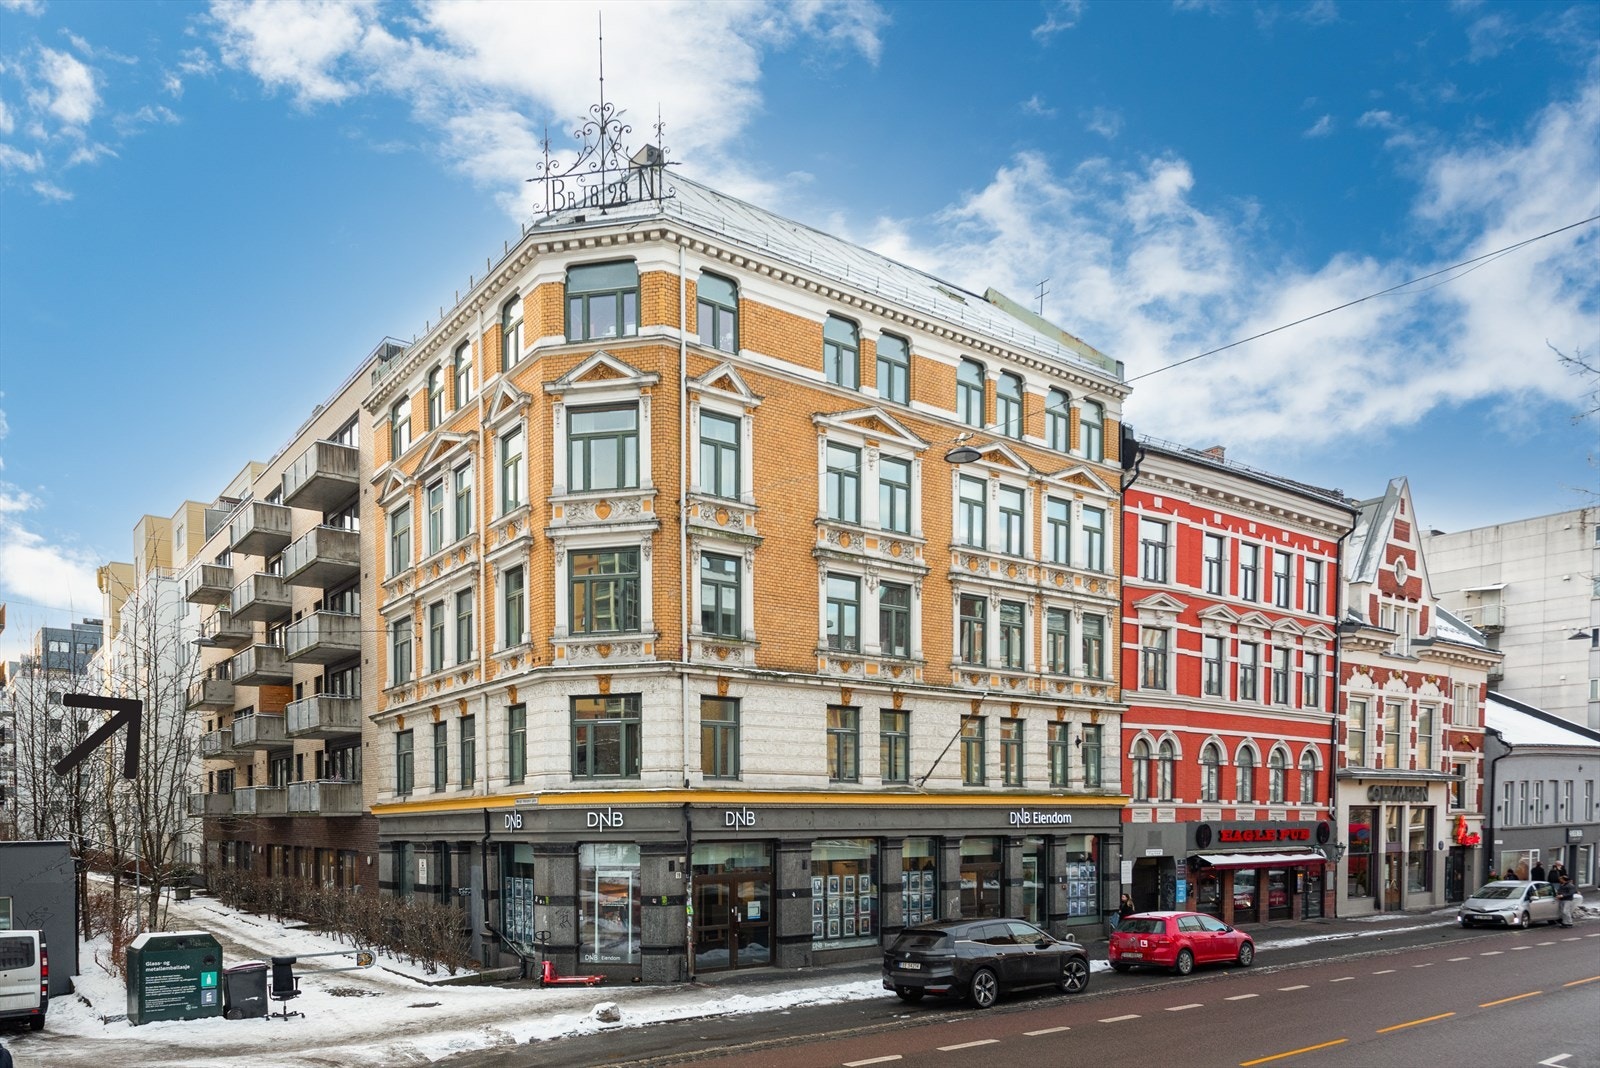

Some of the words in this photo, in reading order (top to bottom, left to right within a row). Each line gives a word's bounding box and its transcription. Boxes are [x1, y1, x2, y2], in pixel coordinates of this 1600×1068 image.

[504, 809, 523, 833] DNB
[587, 806, 624, 833] DNB
[725, 806, 756, 831] DNB
[1010, 807, 1031, 828] DNB
[1033, 811, 1072, 824] Eiendom
[1219, 829, 1276, 842] EAGLE
[1278, 828, 1310, 841] PUB
[812, 941, 823, 950] DNB
[584, 953, 599, 963] DNB
